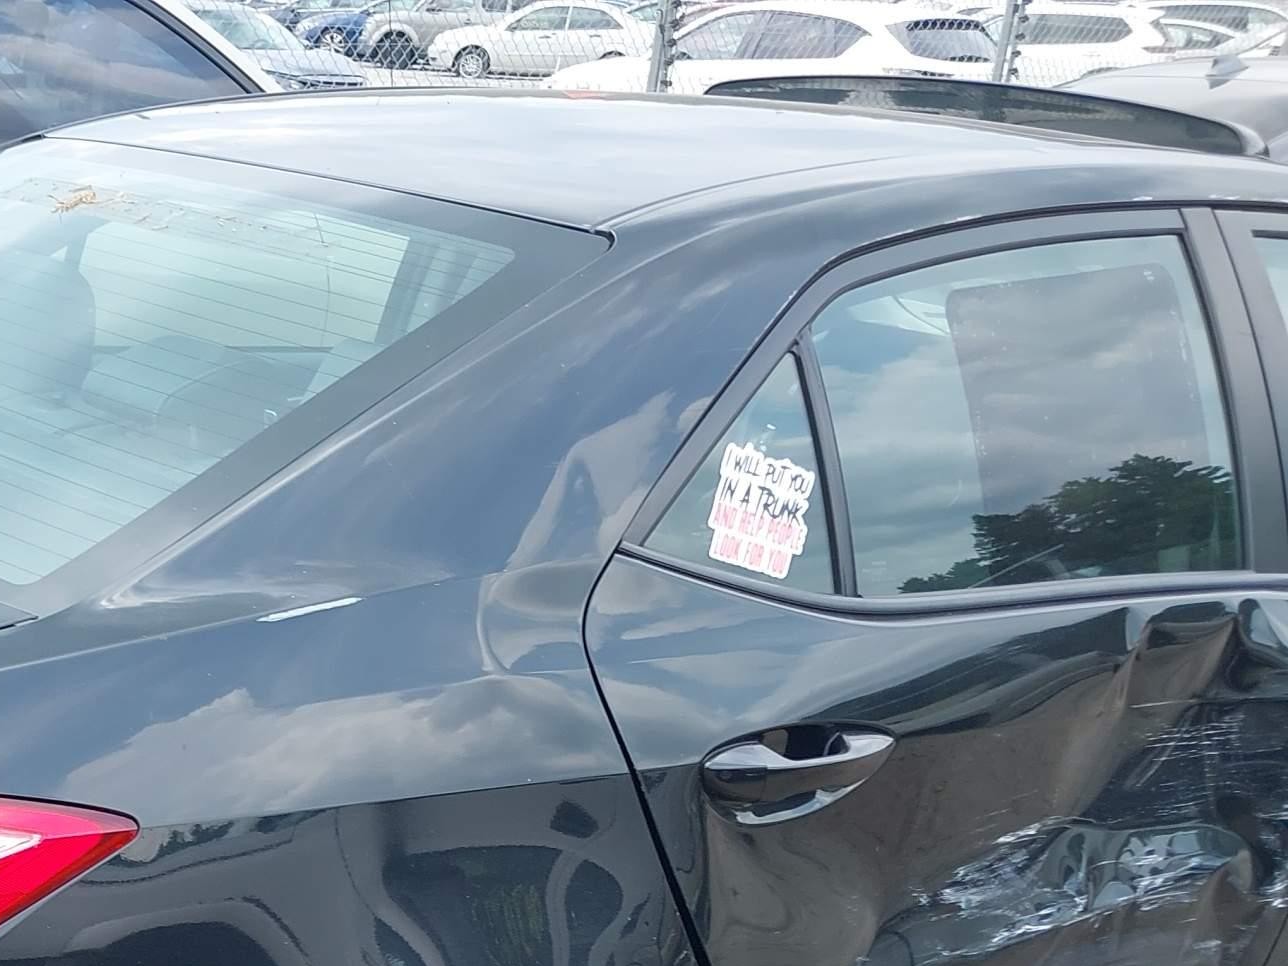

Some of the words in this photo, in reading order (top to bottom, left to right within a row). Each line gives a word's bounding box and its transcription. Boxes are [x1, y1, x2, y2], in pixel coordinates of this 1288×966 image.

[725, 449, 733, 466] I
[733, 454, 761, 477] WILL
[764, 462, 792, 488] PUT
[787, 473, 811, 494] YOU
[718, 477, 741, 504] IN
[738, 481, 753, 514] A
[752, 485, 802, 528] TRUNK
[713, 502, 738, 530] AND
[765, 517, 804, 552] PEOPLE
[712, 533, 743, 561] LOOK
[743, 541, 765, 567] FOR
[767, 549, 789, 575] YOU
